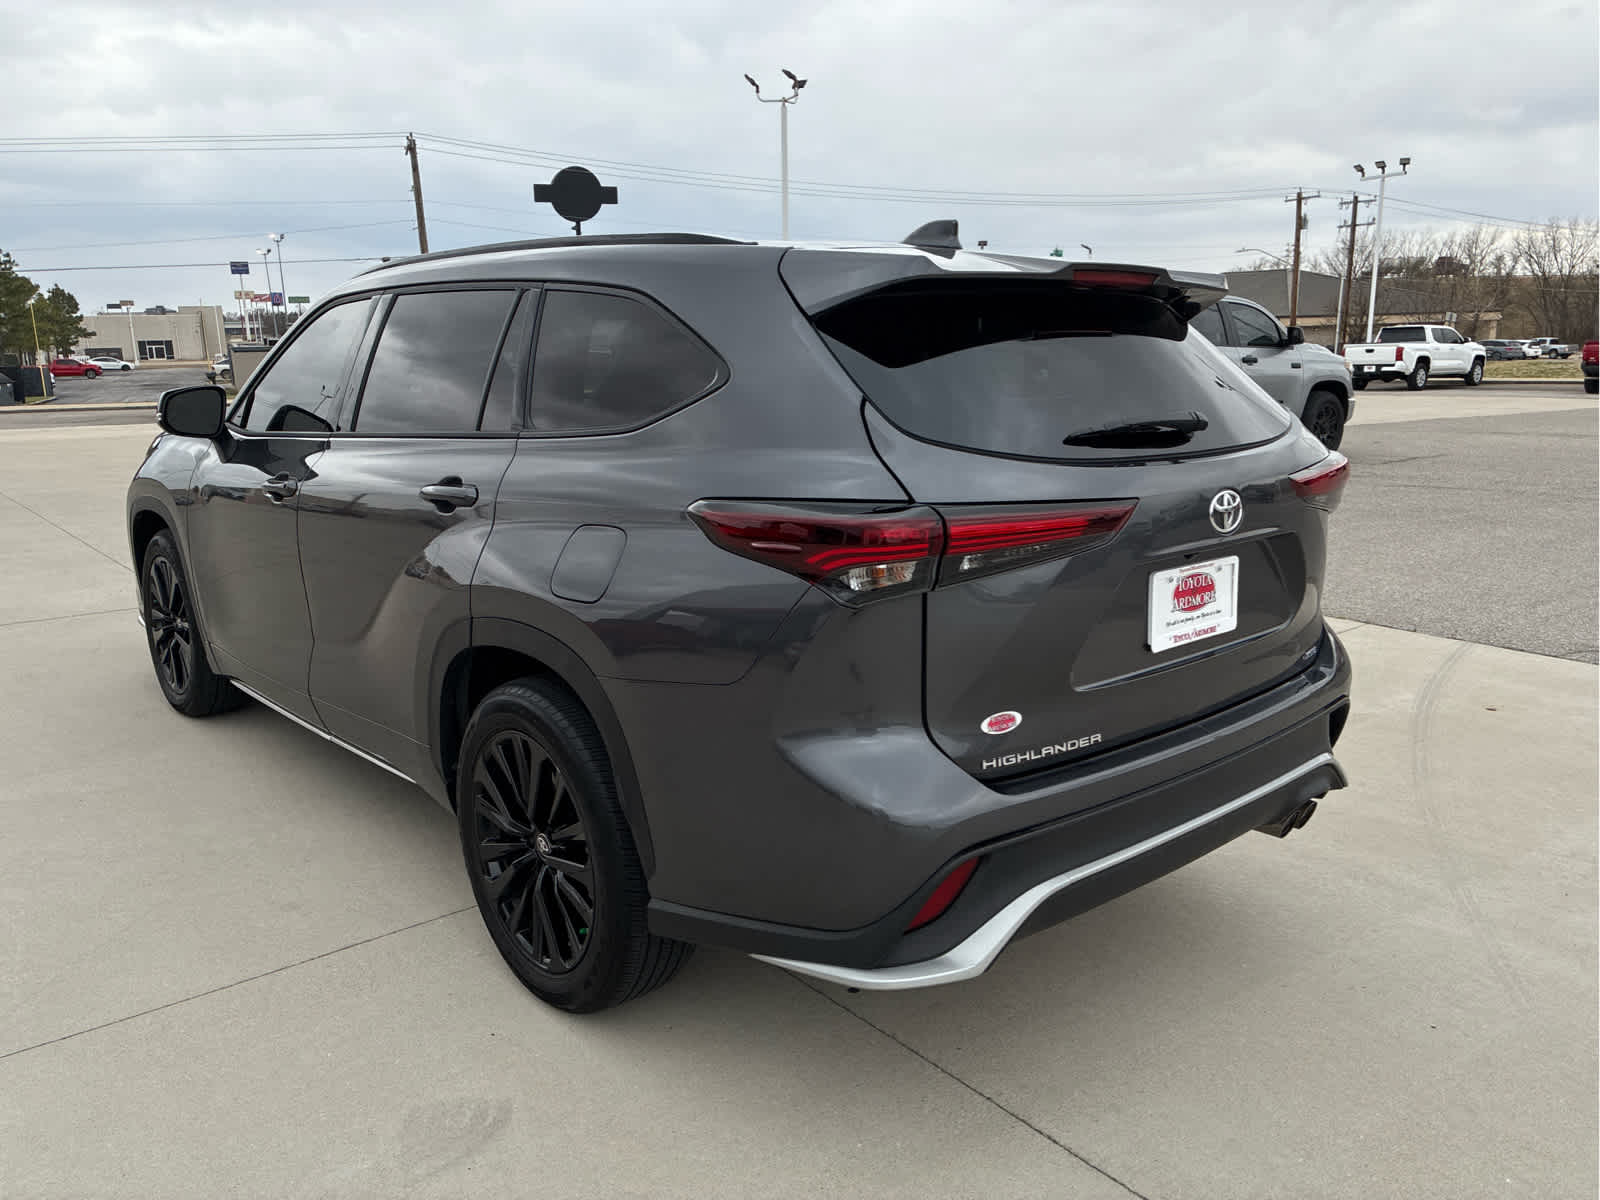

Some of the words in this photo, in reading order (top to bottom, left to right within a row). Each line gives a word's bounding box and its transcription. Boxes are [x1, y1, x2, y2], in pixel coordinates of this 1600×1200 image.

[1176, 575, 1213, 592] TOYOTA
[1172, 591, 1216, 611] ARDMORE
[982, 733, 1102, 770] HIGHLANDER
